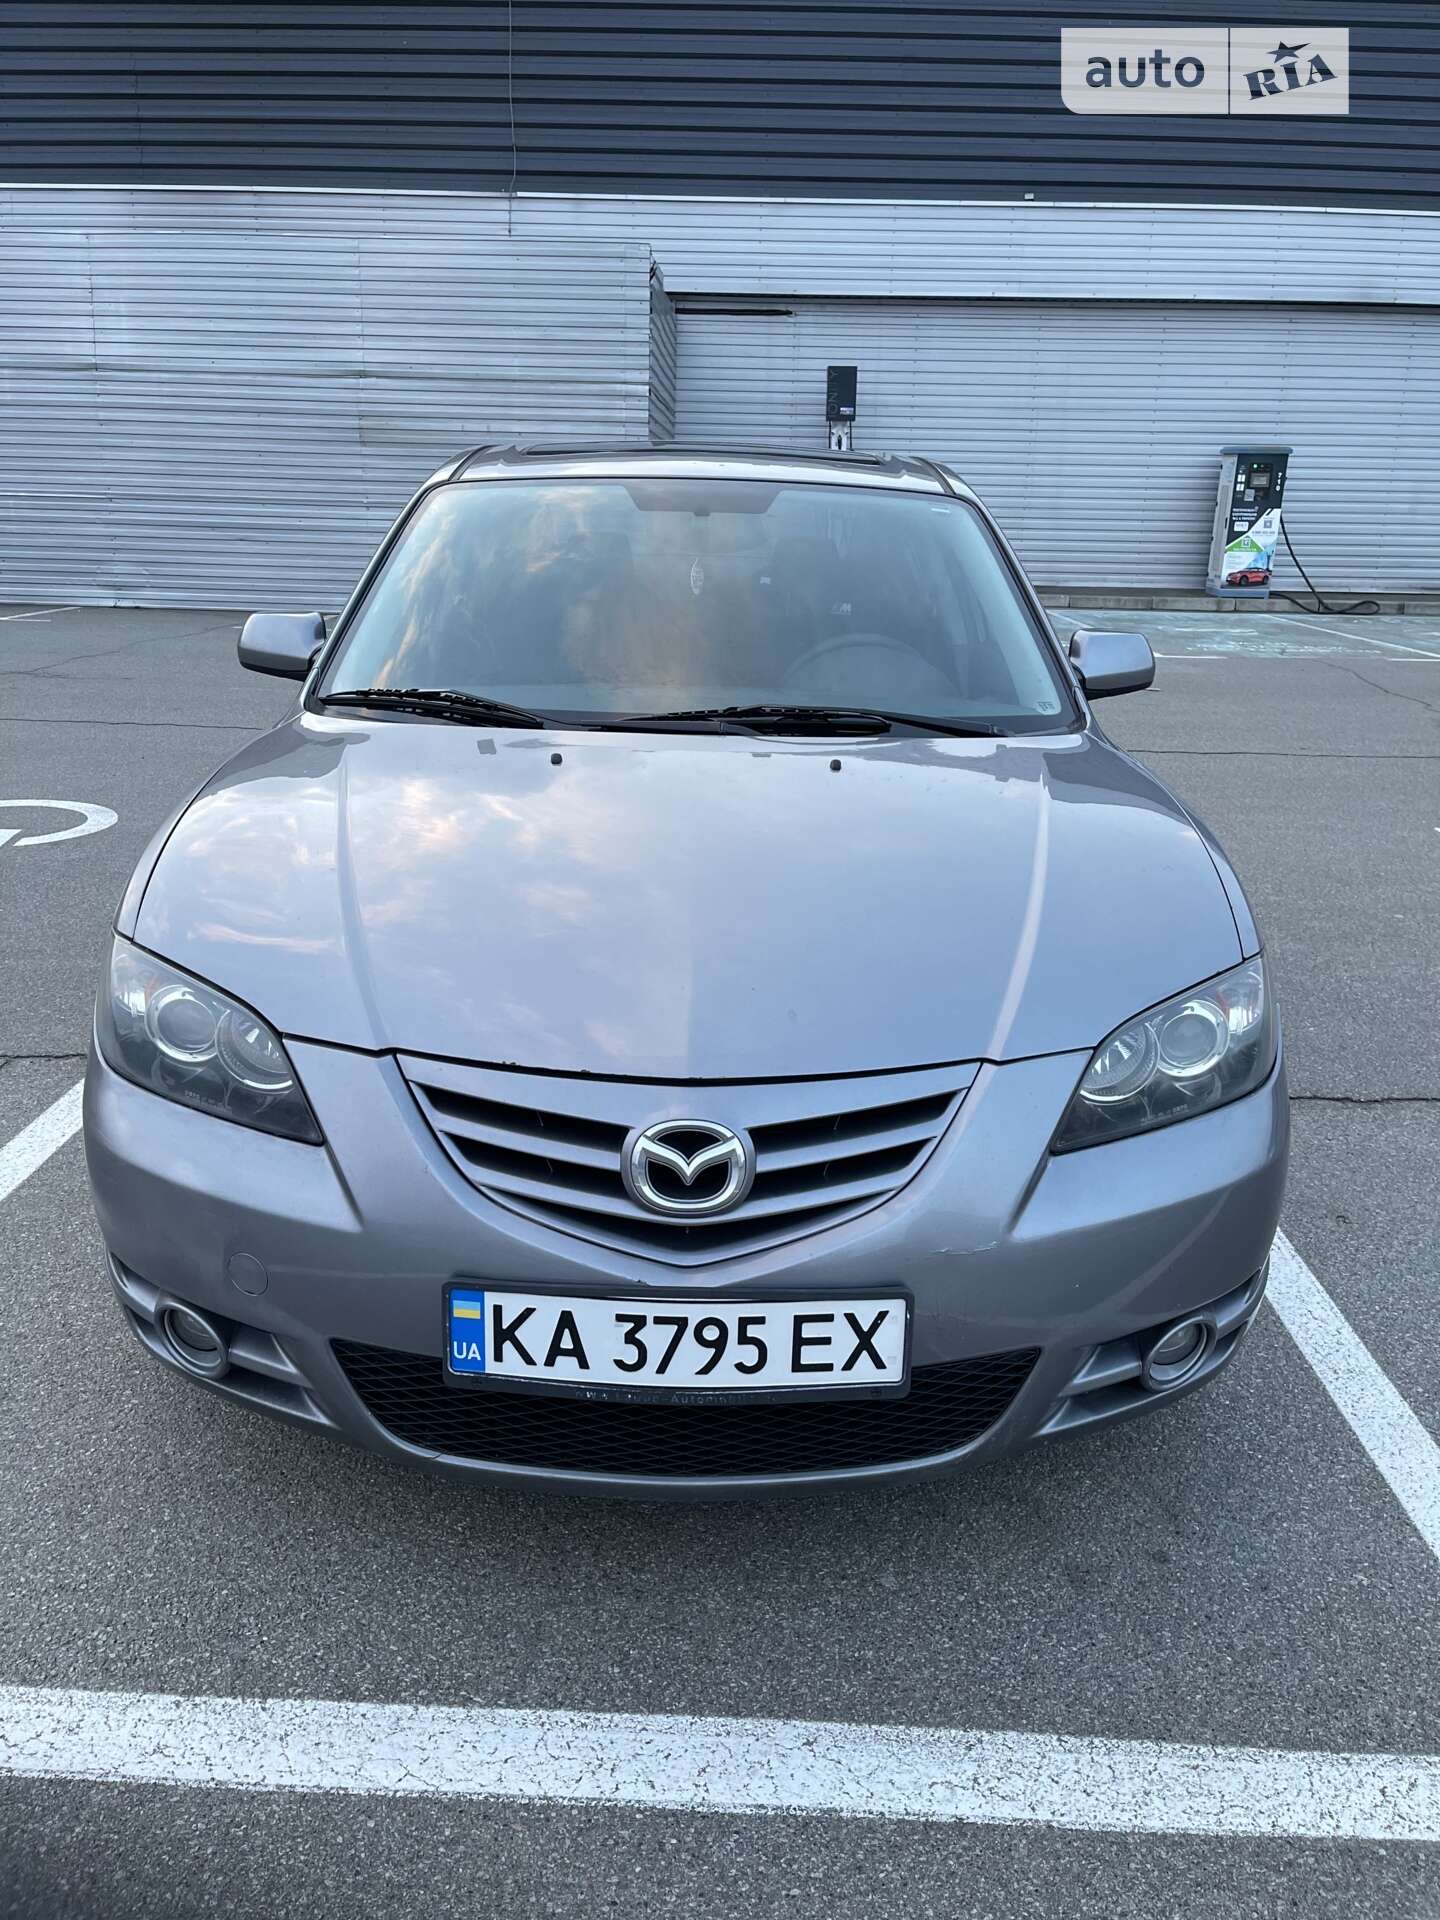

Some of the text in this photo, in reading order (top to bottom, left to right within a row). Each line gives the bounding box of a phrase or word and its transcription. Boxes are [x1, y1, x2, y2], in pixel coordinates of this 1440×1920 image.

[453, 1342, 482, 1361] UA
[493, 1305, 890, 1375] KA 3795 EX
